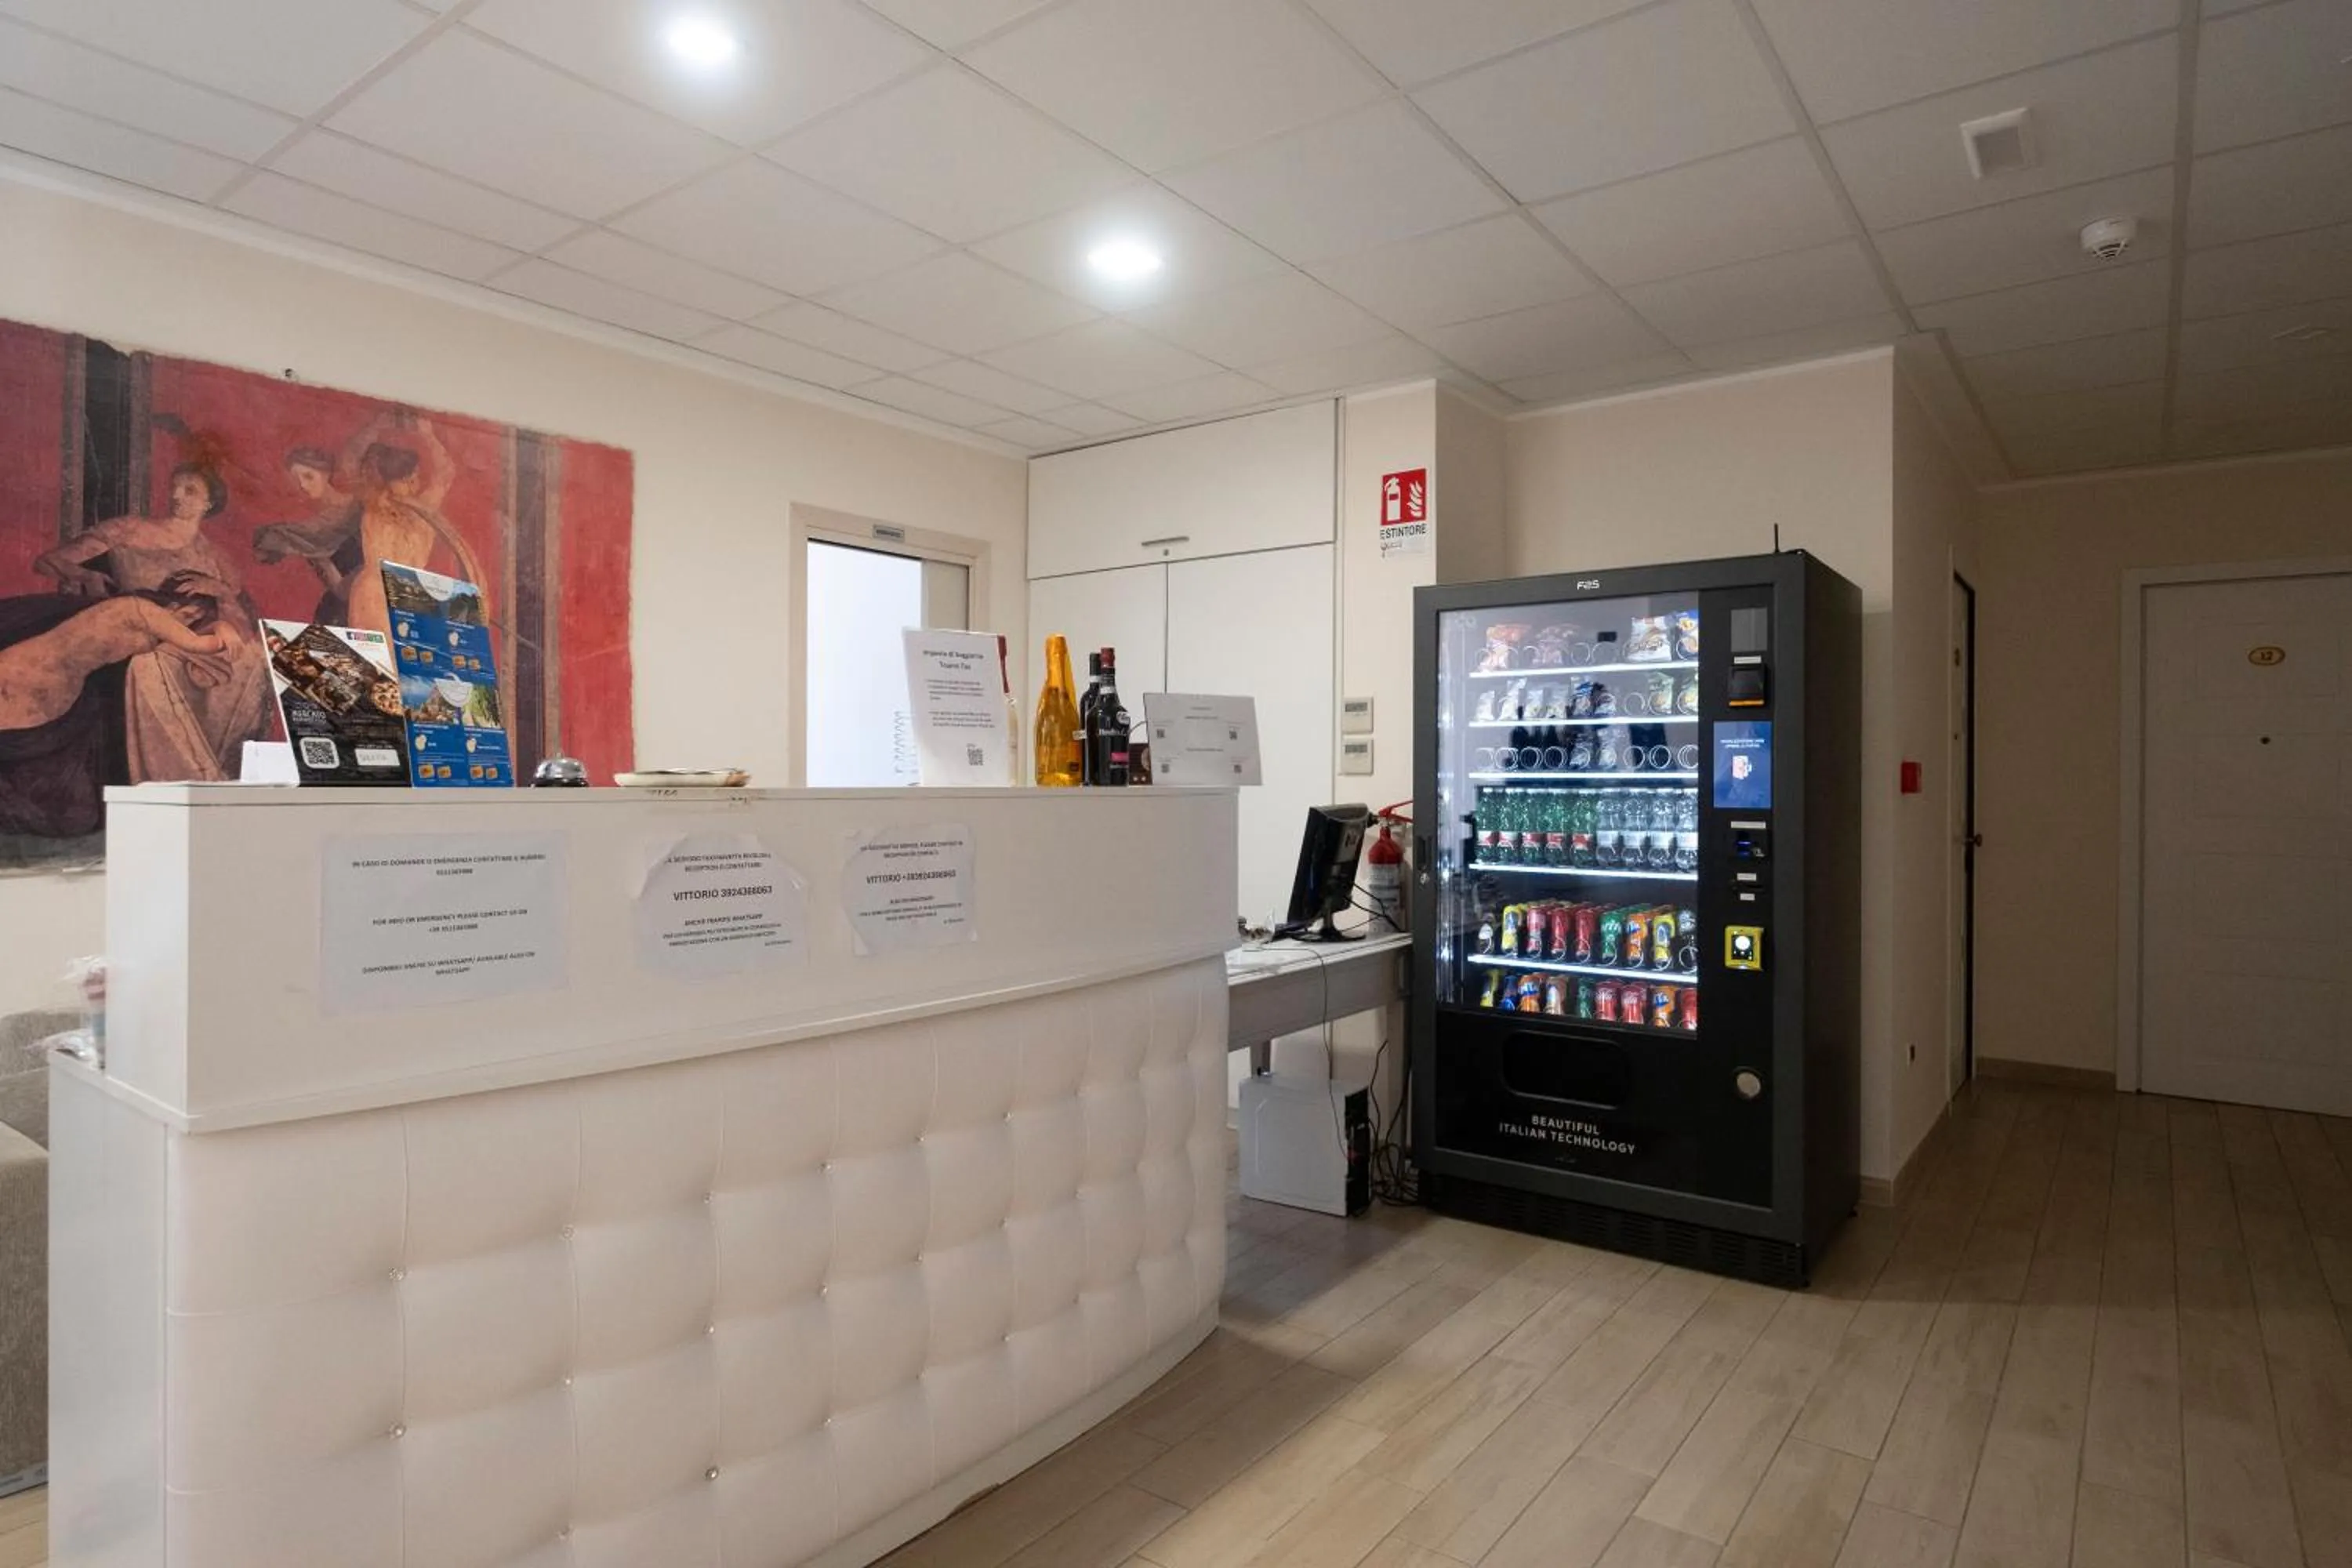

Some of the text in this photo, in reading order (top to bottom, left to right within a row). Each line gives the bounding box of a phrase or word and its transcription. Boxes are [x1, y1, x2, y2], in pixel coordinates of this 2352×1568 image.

[1380, 523, 1427, 539] ESTINTORE
[866, 873, 901, 884] VITTORIO
[673, 888, 719, 901] VITTORIO
[1531, 1114, 1600, 1135] BEAUTIFUL
[1499, 1122, 1635, 1154] ITALIAN TECHNOLOGY
